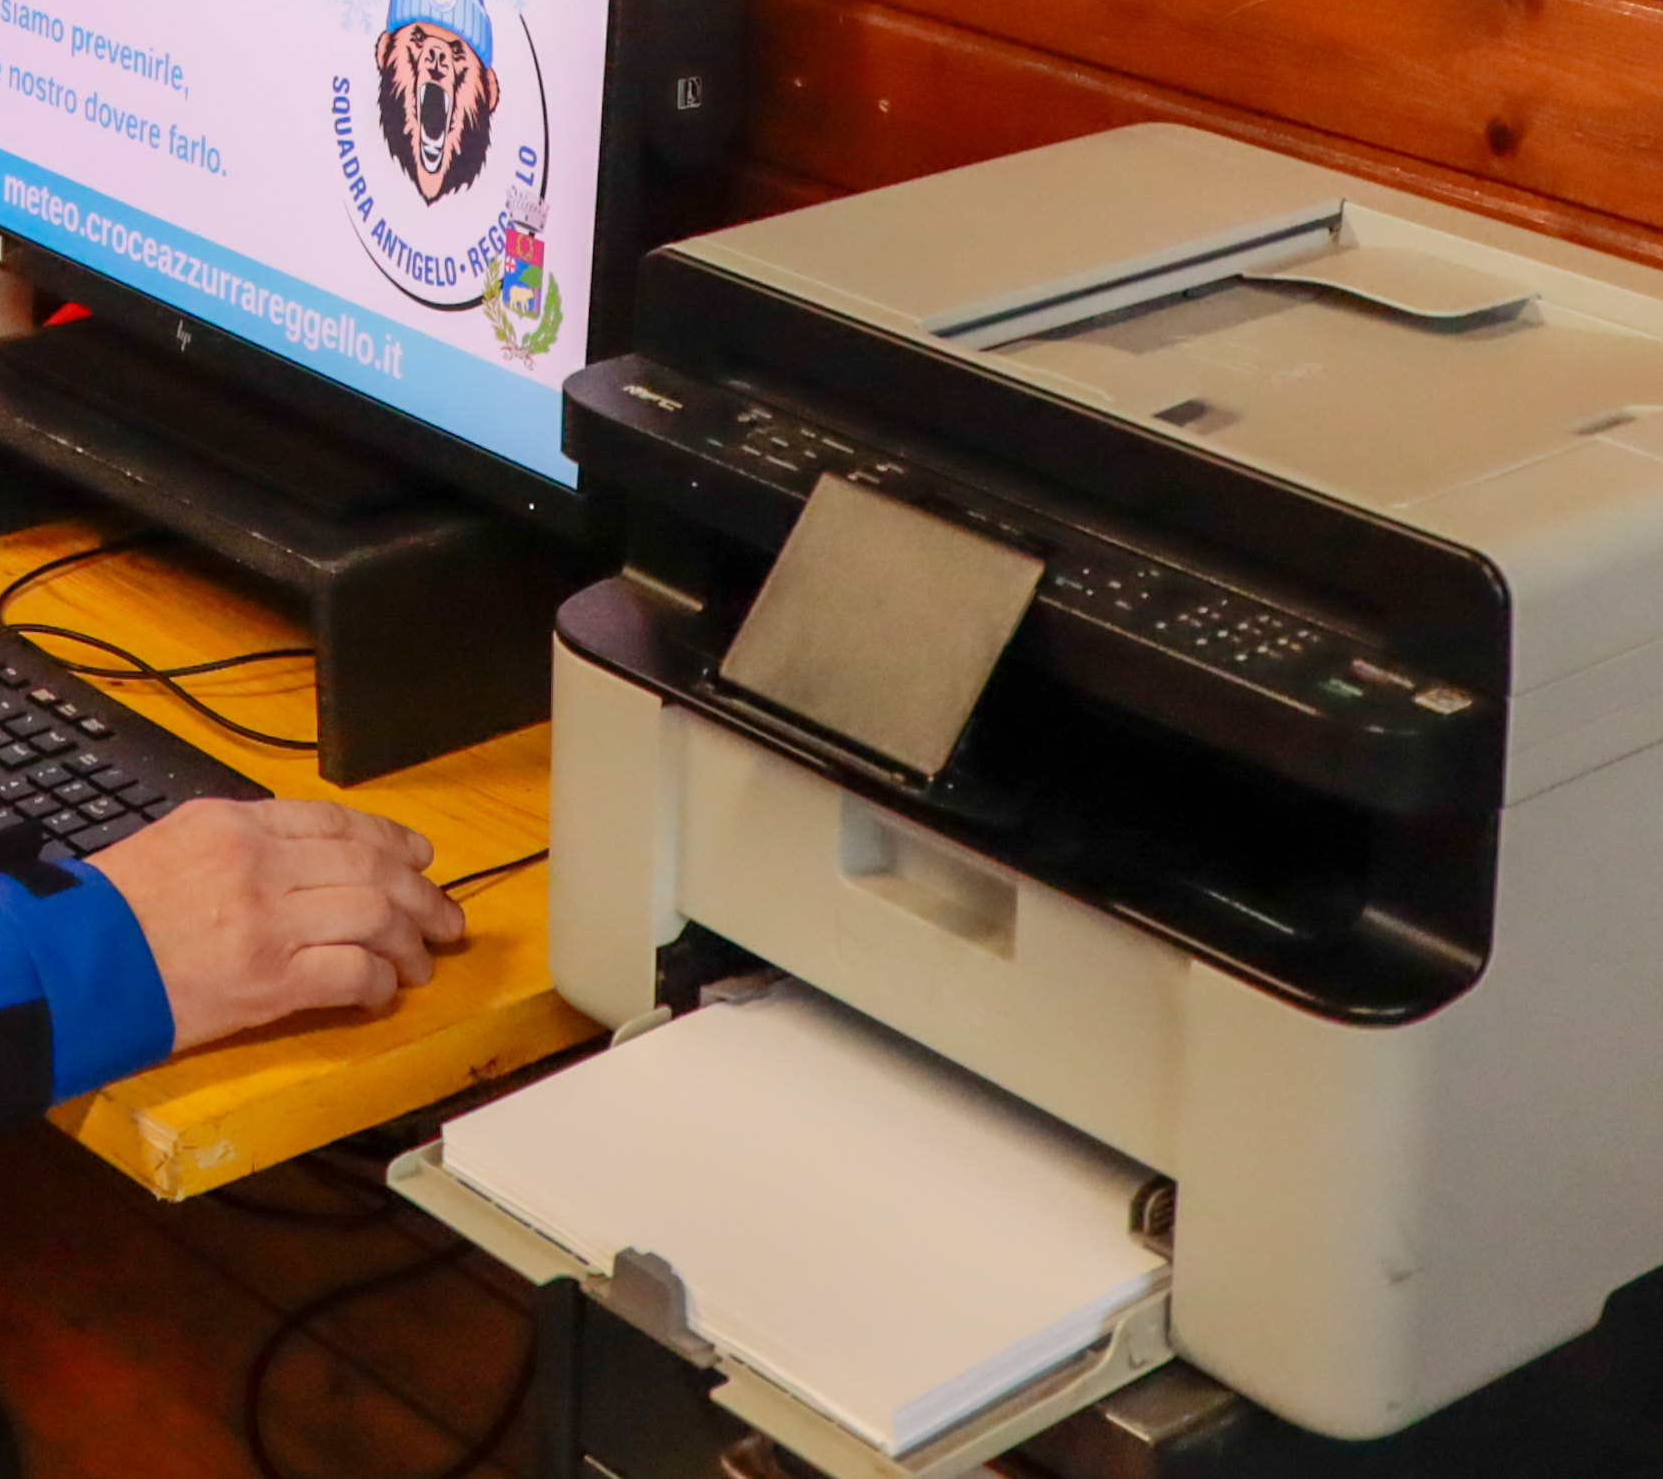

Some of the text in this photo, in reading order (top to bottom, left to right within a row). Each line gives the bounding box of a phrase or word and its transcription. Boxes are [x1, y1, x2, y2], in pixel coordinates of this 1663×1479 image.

[8, 60, 77, 113] nostro
[84, 86, 161, 148] dovere
[168, 119, 227, 177] farlo.
[71, 24, 190, 101] prevenirle,
[331, 76, 373, 224] SQUADRA
[371, 218, 457, 287] ANTIGELO
[3, 170, 403, 380] meteo.croceazzurrareggello.it
